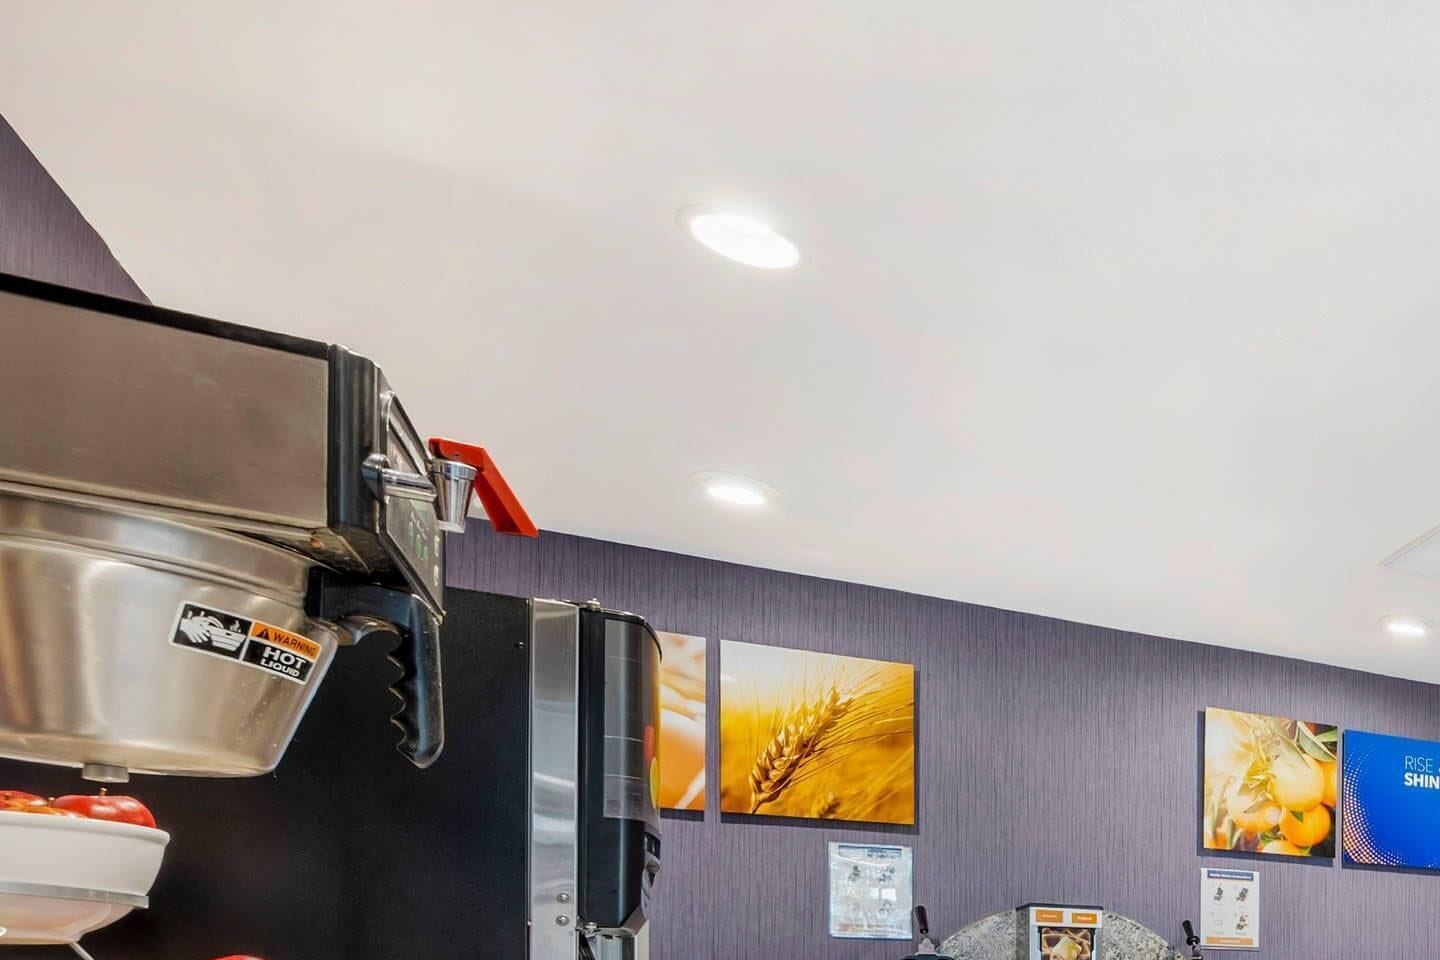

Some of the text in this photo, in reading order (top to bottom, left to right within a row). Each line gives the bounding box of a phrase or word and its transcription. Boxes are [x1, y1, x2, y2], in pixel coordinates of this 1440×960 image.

[273, 631, 317, 658] WARNING
[260, 657, 300, 678] LIQUID
[263, 646, 307, 669] HOT
[1404, 755, 1434, 773] RISE
